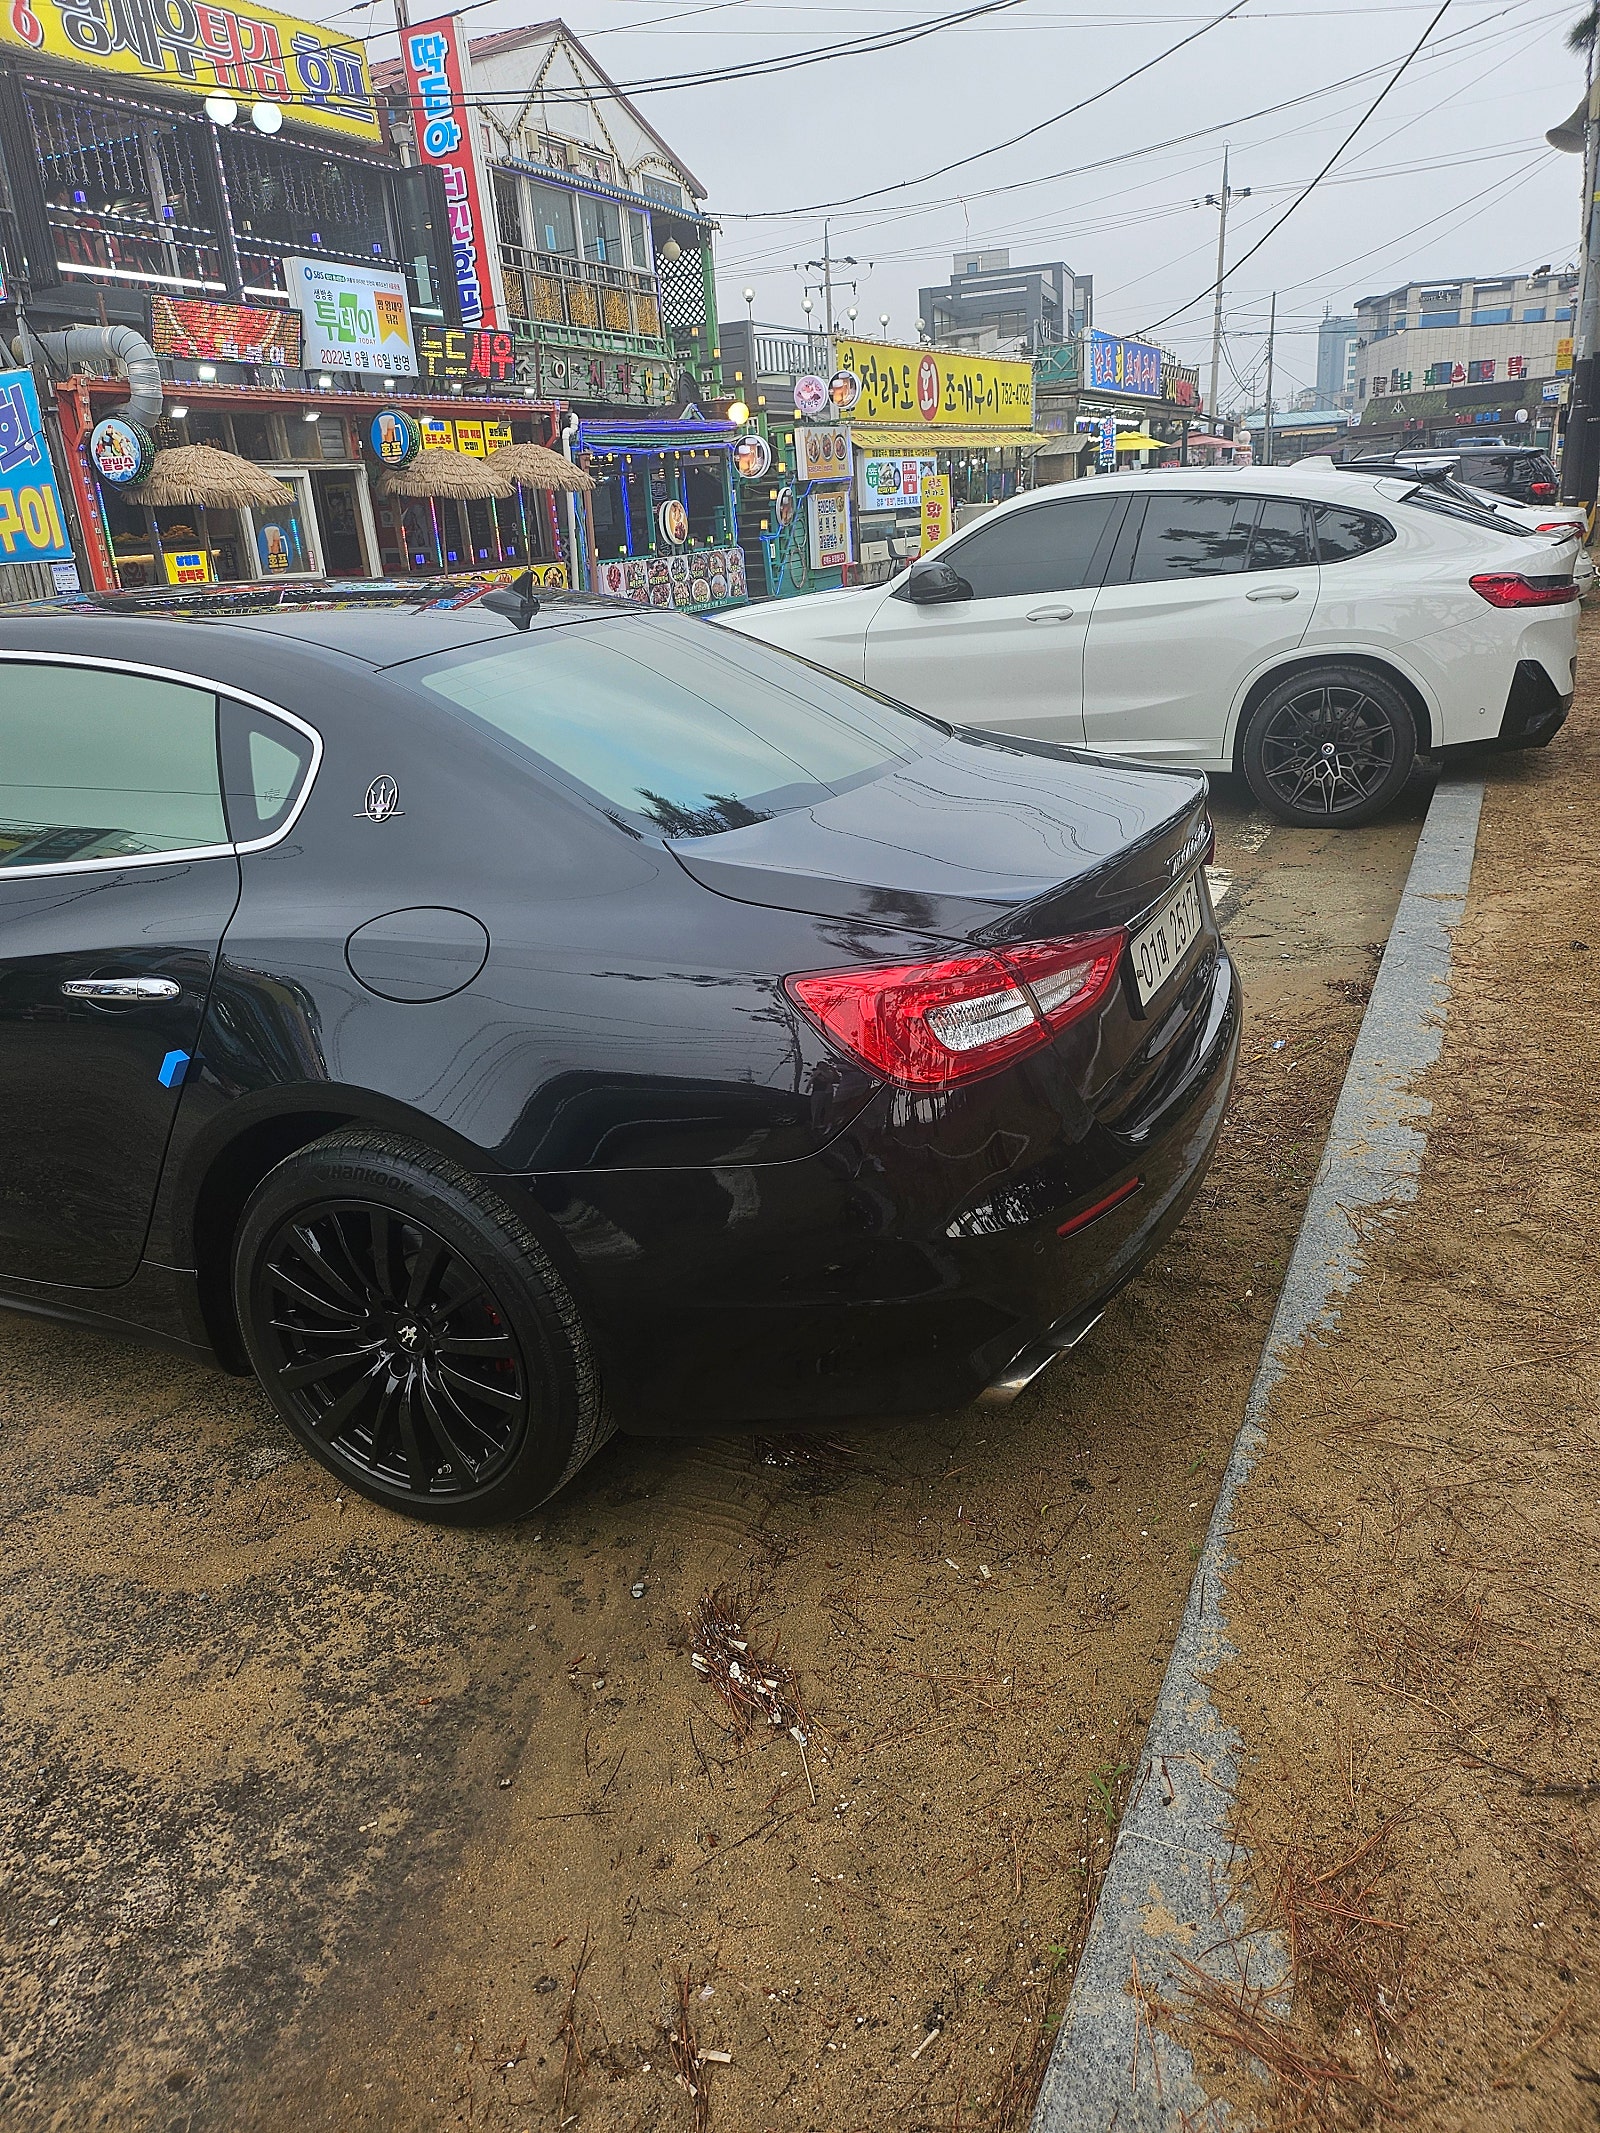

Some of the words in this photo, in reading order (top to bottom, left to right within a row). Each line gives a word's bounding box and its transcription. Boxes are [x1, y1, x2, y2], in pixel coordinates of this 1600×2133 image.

[291, 30, 374, 123] 호프
[313, 269, 325, 280] SBS
[313, 288, 333, 301] 생방송
[313, 299, 376, 341] 투데이
[358, 337, 376, 345] TODAY
[320, 349, 353, 367] 2022년
[354, 350, 370, 369] 8월
[372, 353, 392, 370] 16일
[392, 353, 411, 372] 방영
[860, 354, 914, 417] 전라도
[919, 361, 938, 412] 회
[944, 372, 999, 416] 조개구이
[1001, 382, 1030, 406] 752-4732
[380, 440, 403, 457] 호프
[100, 457, 135, 472] 팥빙수
[924, 488, 945, 499] 전라도
[267, 552, 289, 569] 호프
[177, 568, 205, 583] 생맥주
[1140, 926, 1170, 989] 01마
[1169, 886, 1196, 956] 2517
